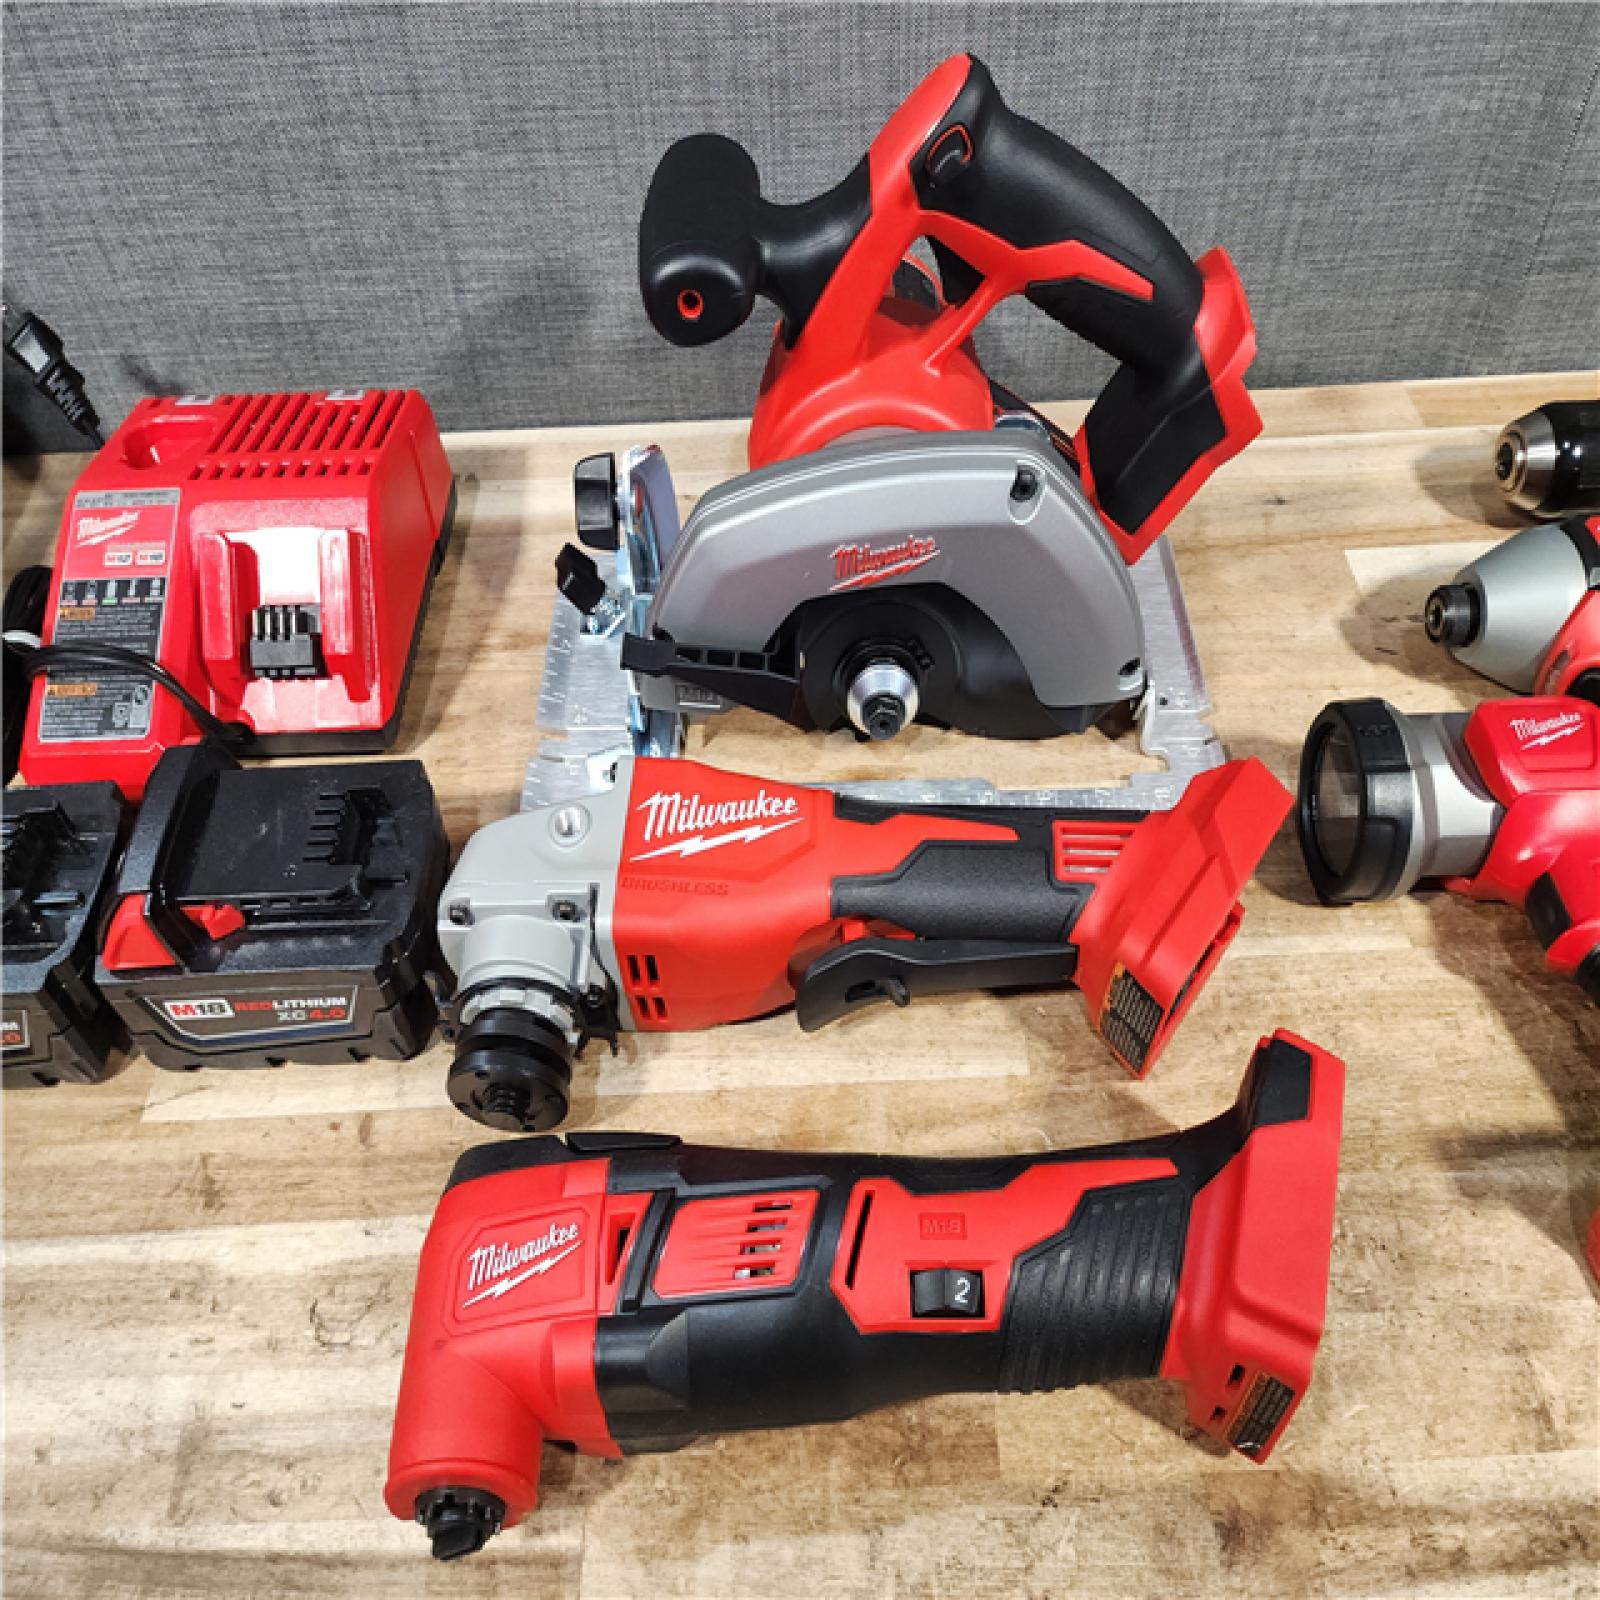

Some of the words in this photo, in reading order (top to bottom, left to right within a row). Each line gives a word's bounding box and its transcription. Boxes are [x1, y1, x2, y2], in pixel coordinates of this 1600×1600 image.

[830, 534, 936, 579] Milwaukee
[1508, 712, 1581, 740] Milwaukee
[637, 789, 799, 841] Milwaukee
[170, 1003, 226, 1016] M18
[924, 1219, 961, 1234] M18
[467, 1222, 578, 1291] Milwaukee
[954, 1276, 971, 1304] 2
